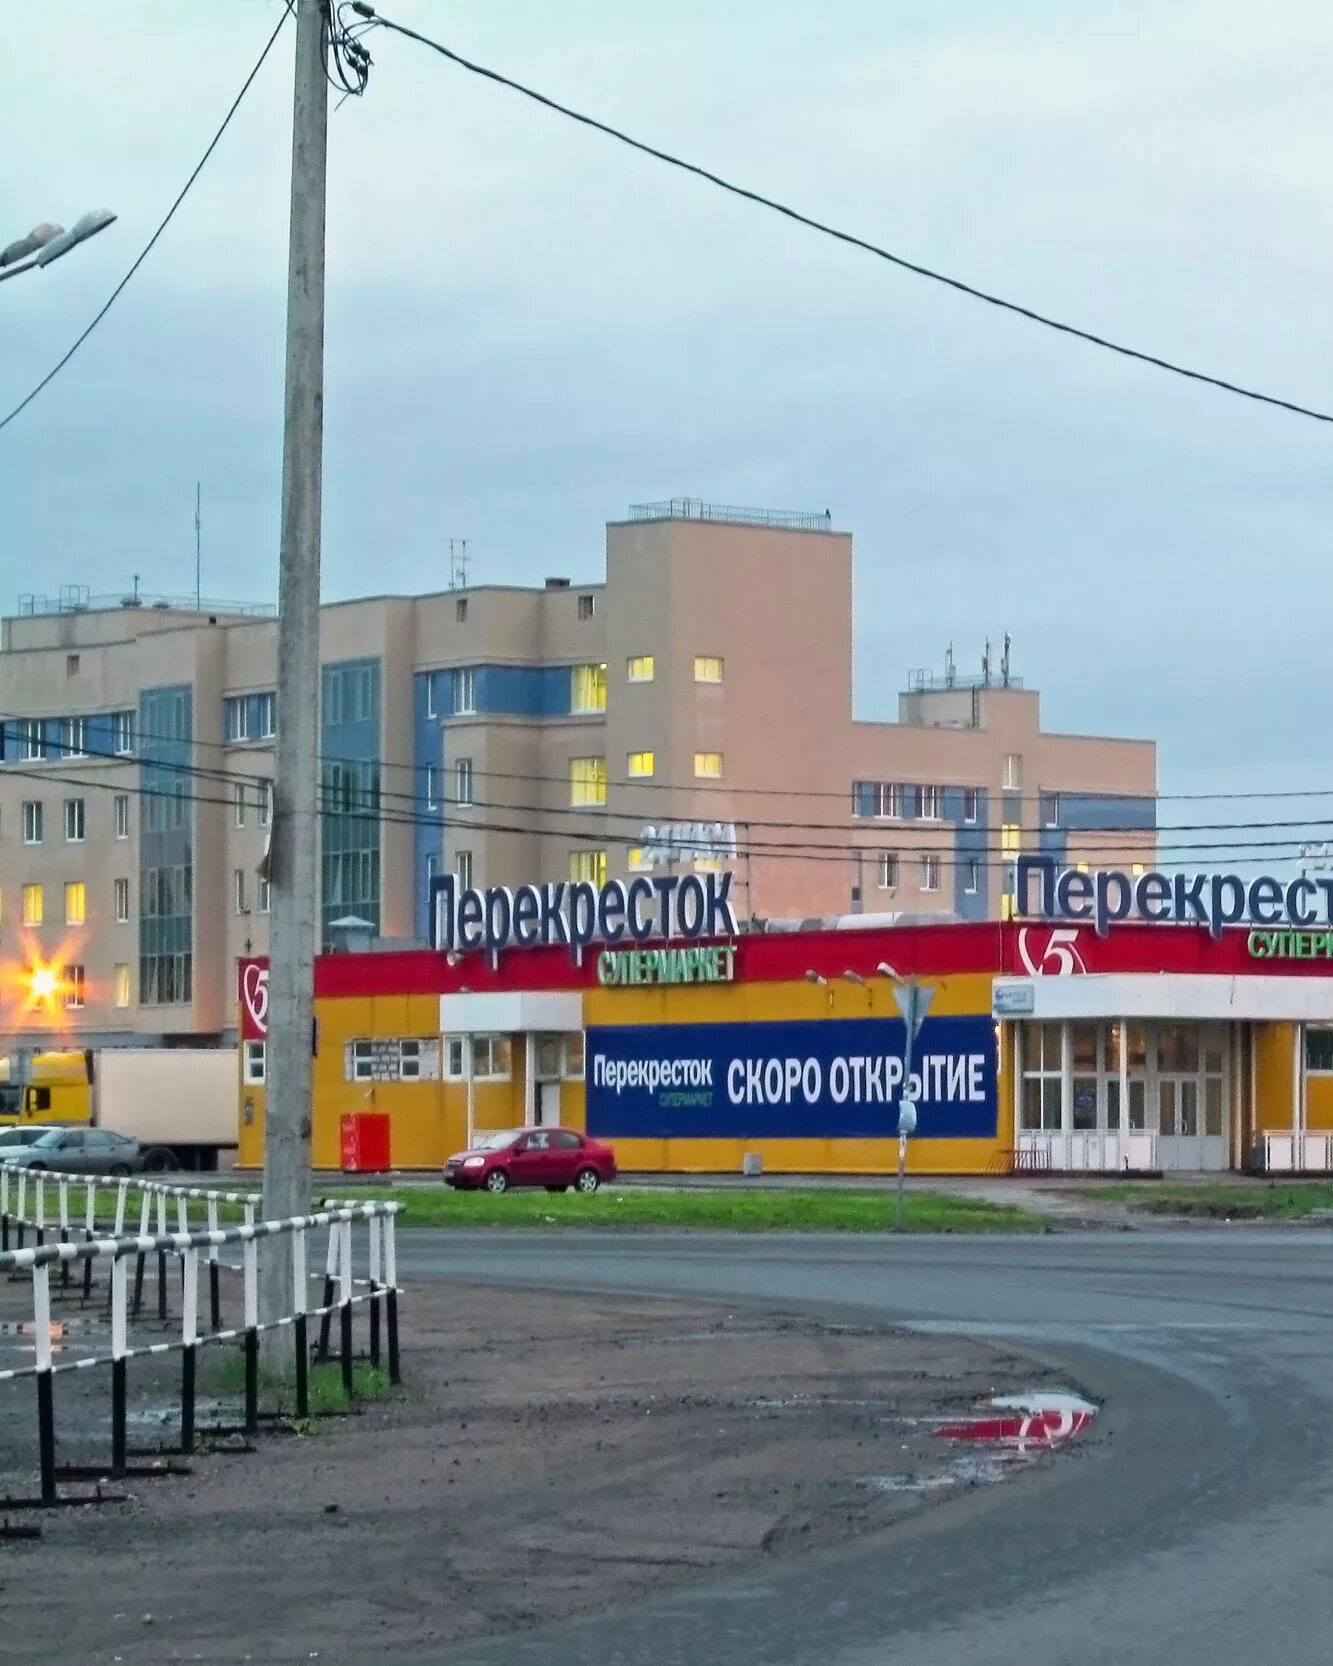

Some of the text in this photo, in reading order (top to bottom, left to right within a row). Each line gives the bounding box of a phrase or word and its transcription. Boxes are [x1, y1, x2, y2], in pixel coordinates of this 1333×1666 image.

[428, 871, 740, 970] Перекресток
[597, 946, 738, 985] СУПЕРМАРКЕТ
[594, 1054, 712, 1095] Перекресток
[727, 1054, 986, 1104] СКОРО ОТКРЫТИЕ
